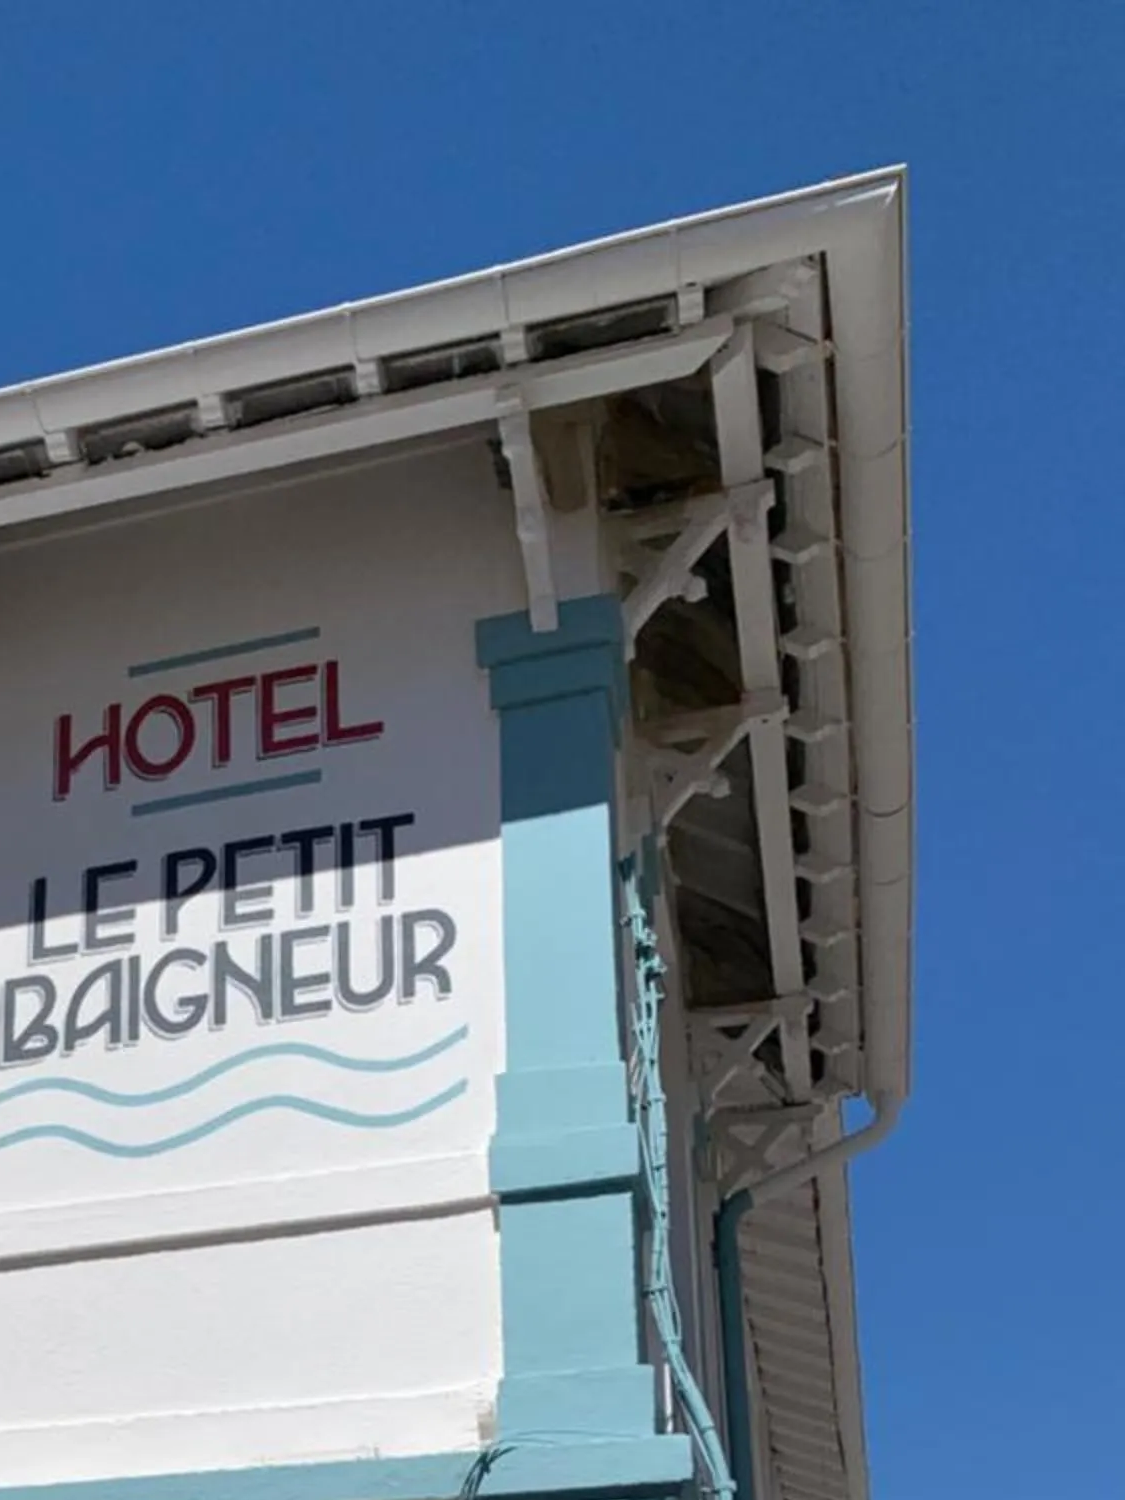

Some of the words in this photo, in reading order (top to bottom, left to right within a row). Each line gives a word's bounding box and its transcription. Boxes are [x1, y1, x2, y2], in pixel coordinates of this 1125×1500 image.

[52, 660, 385, 802] HOTEL
[26, 859, 138, 967] LE
[159, 812, 415, 942] PETIT
